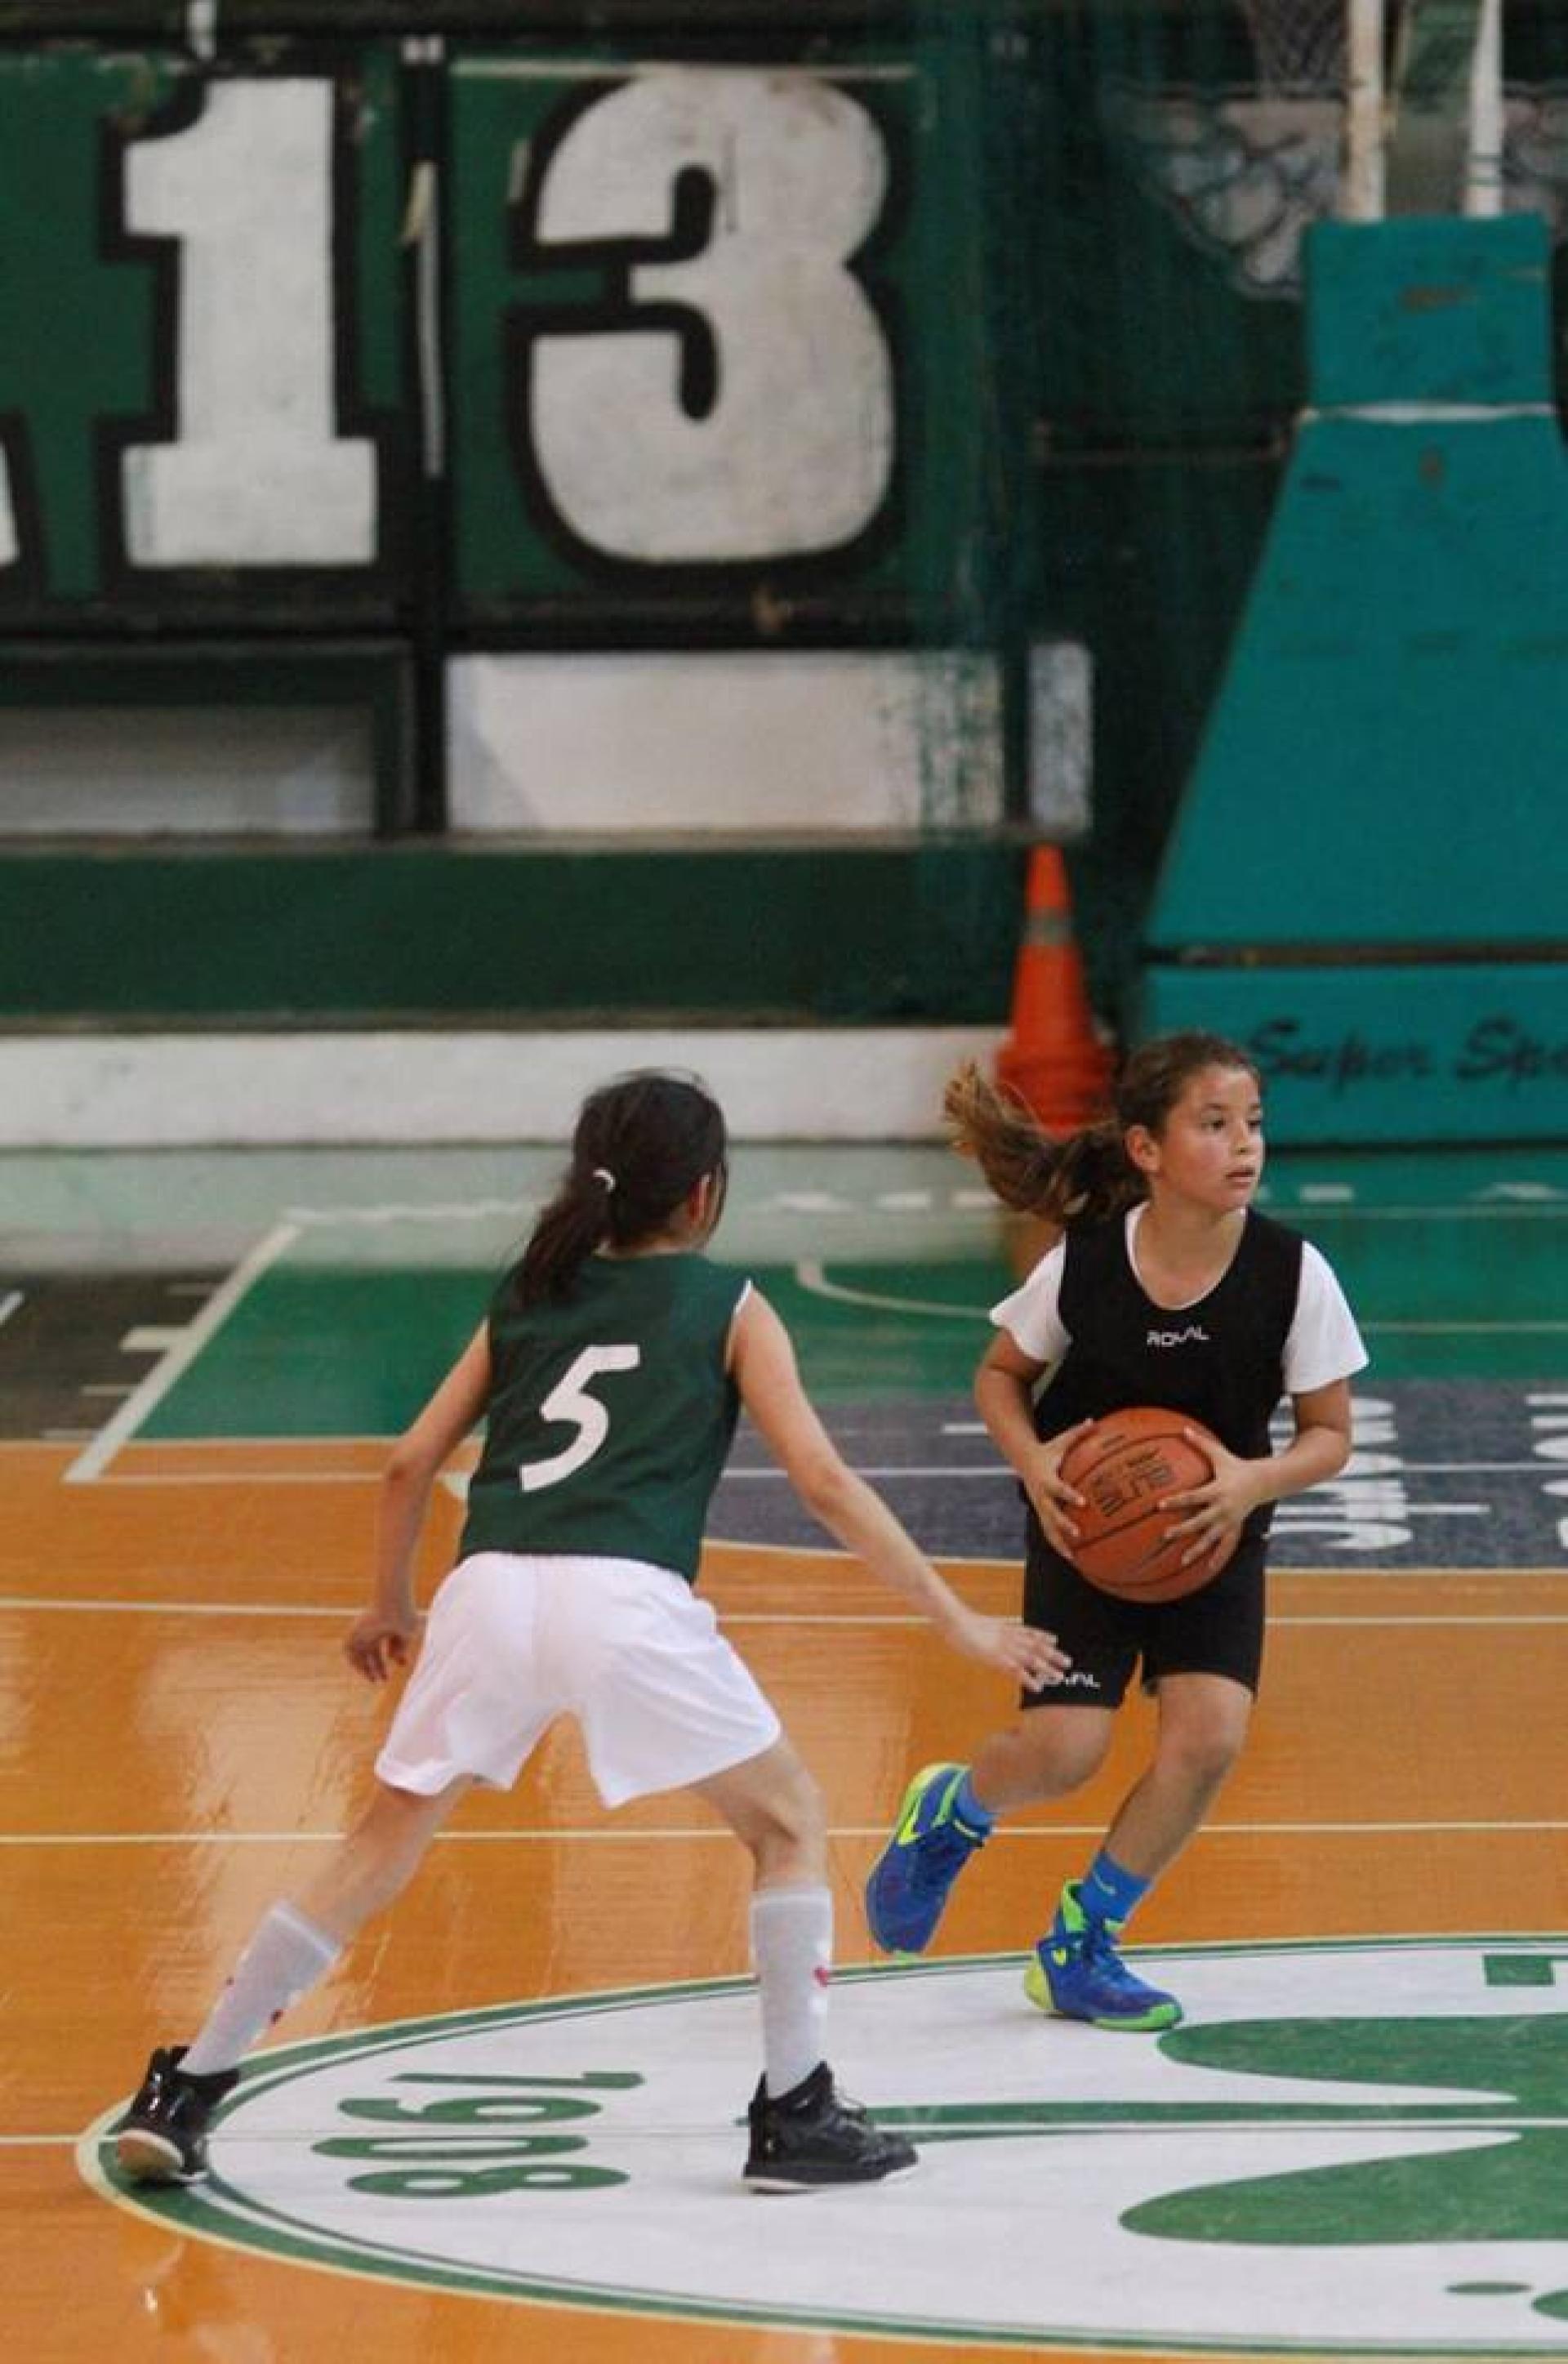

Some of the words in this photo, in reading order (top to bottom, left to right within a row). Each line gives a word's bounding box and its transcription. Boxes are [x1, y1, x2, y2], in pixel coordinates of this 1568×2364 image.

[122, 74, 896, 567] 13
[519, 1345, 640, 1493] 5
[310, 2071, 645, 2199] 1908
